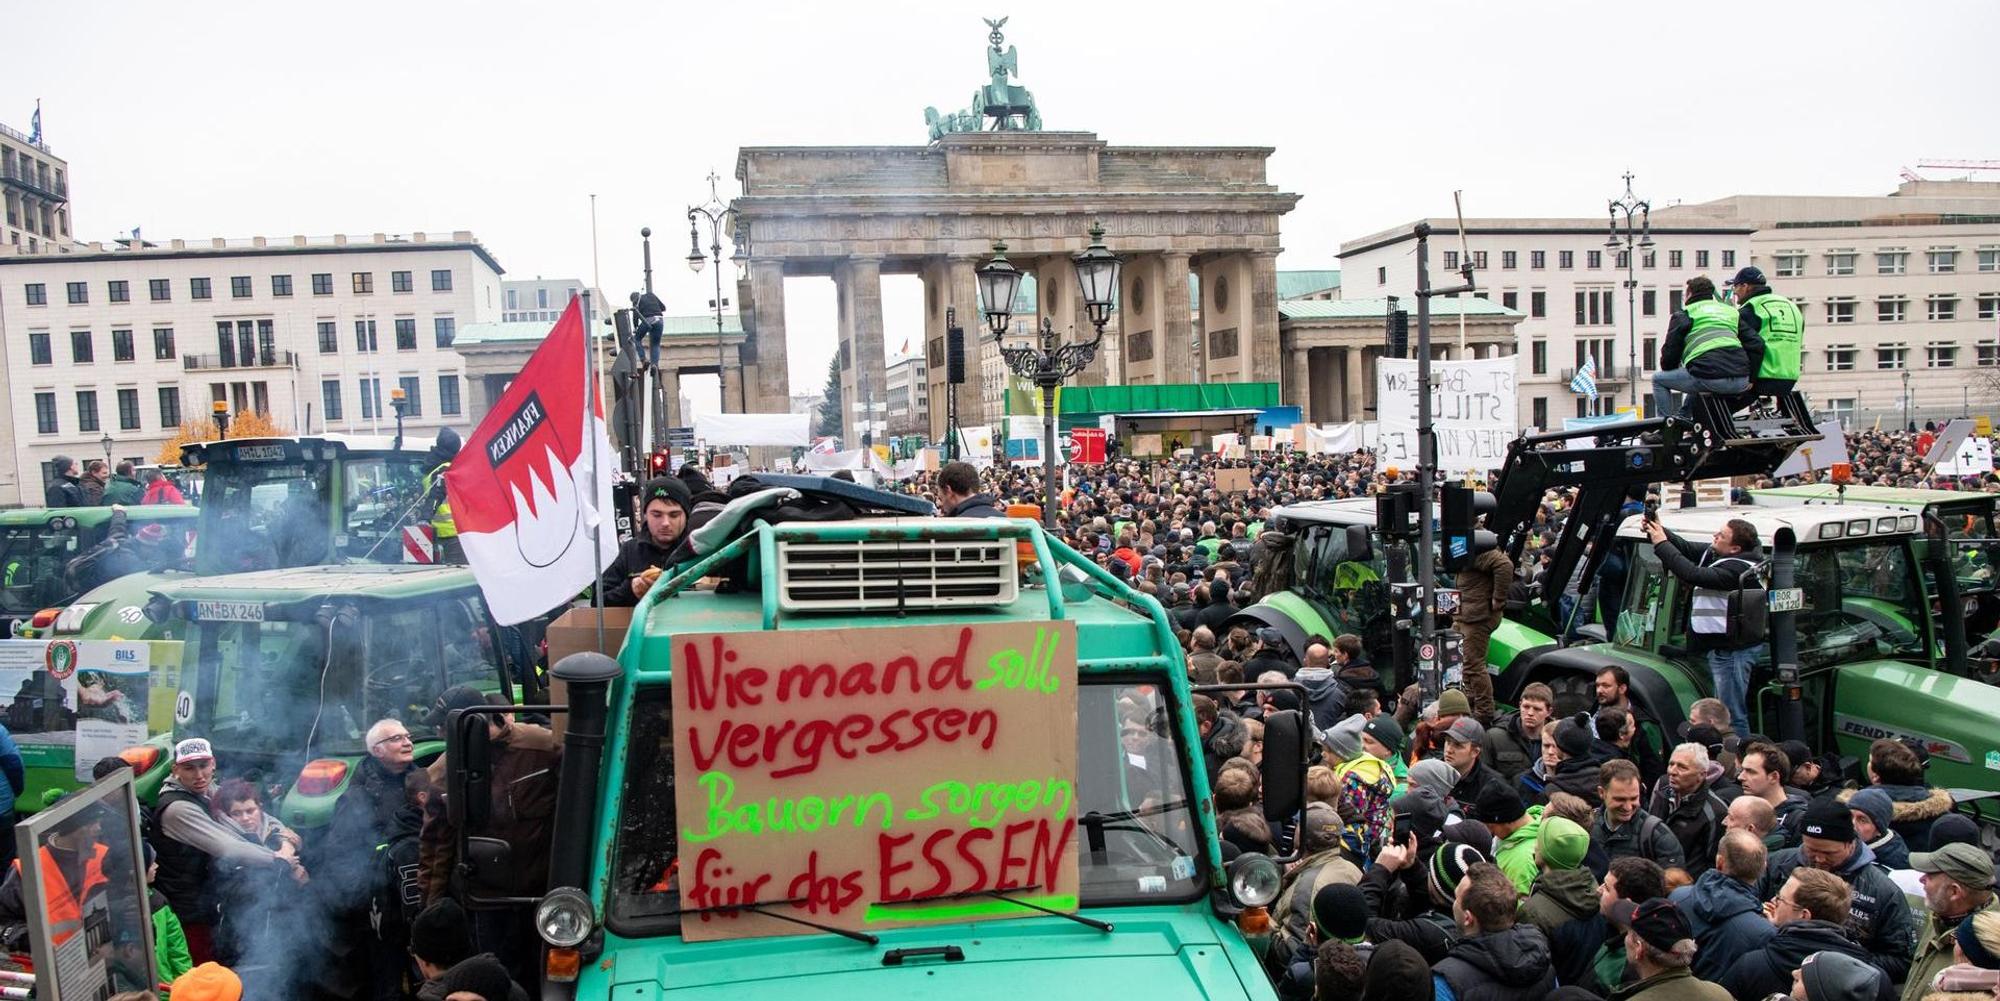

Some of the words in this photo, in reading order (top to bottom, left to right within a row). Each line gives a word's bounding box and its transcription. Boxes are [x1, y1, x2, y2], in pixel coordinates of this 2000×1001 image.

[1776, 591, 1791, 601] BOR
[199, 603, 214, 619] AN
[222, 604, 237, 619] BX
[240, 604, 263, 620] 246
[115, 649, 135, 660] BILS
[684, 627, 973, 711] Niemand
[976, 627, 1061, 694] soll
[176, 696, 190, 718] 40
[1844, 721, 1895, 740] FENDT
[683, 771, 892, 843] Bauern
[905, 777, 1072, 828] sorgen
[688, 847, 772, 922] für
[787, 850, 864, 915] das
[876, 818, 1075, 904] ESSEN
